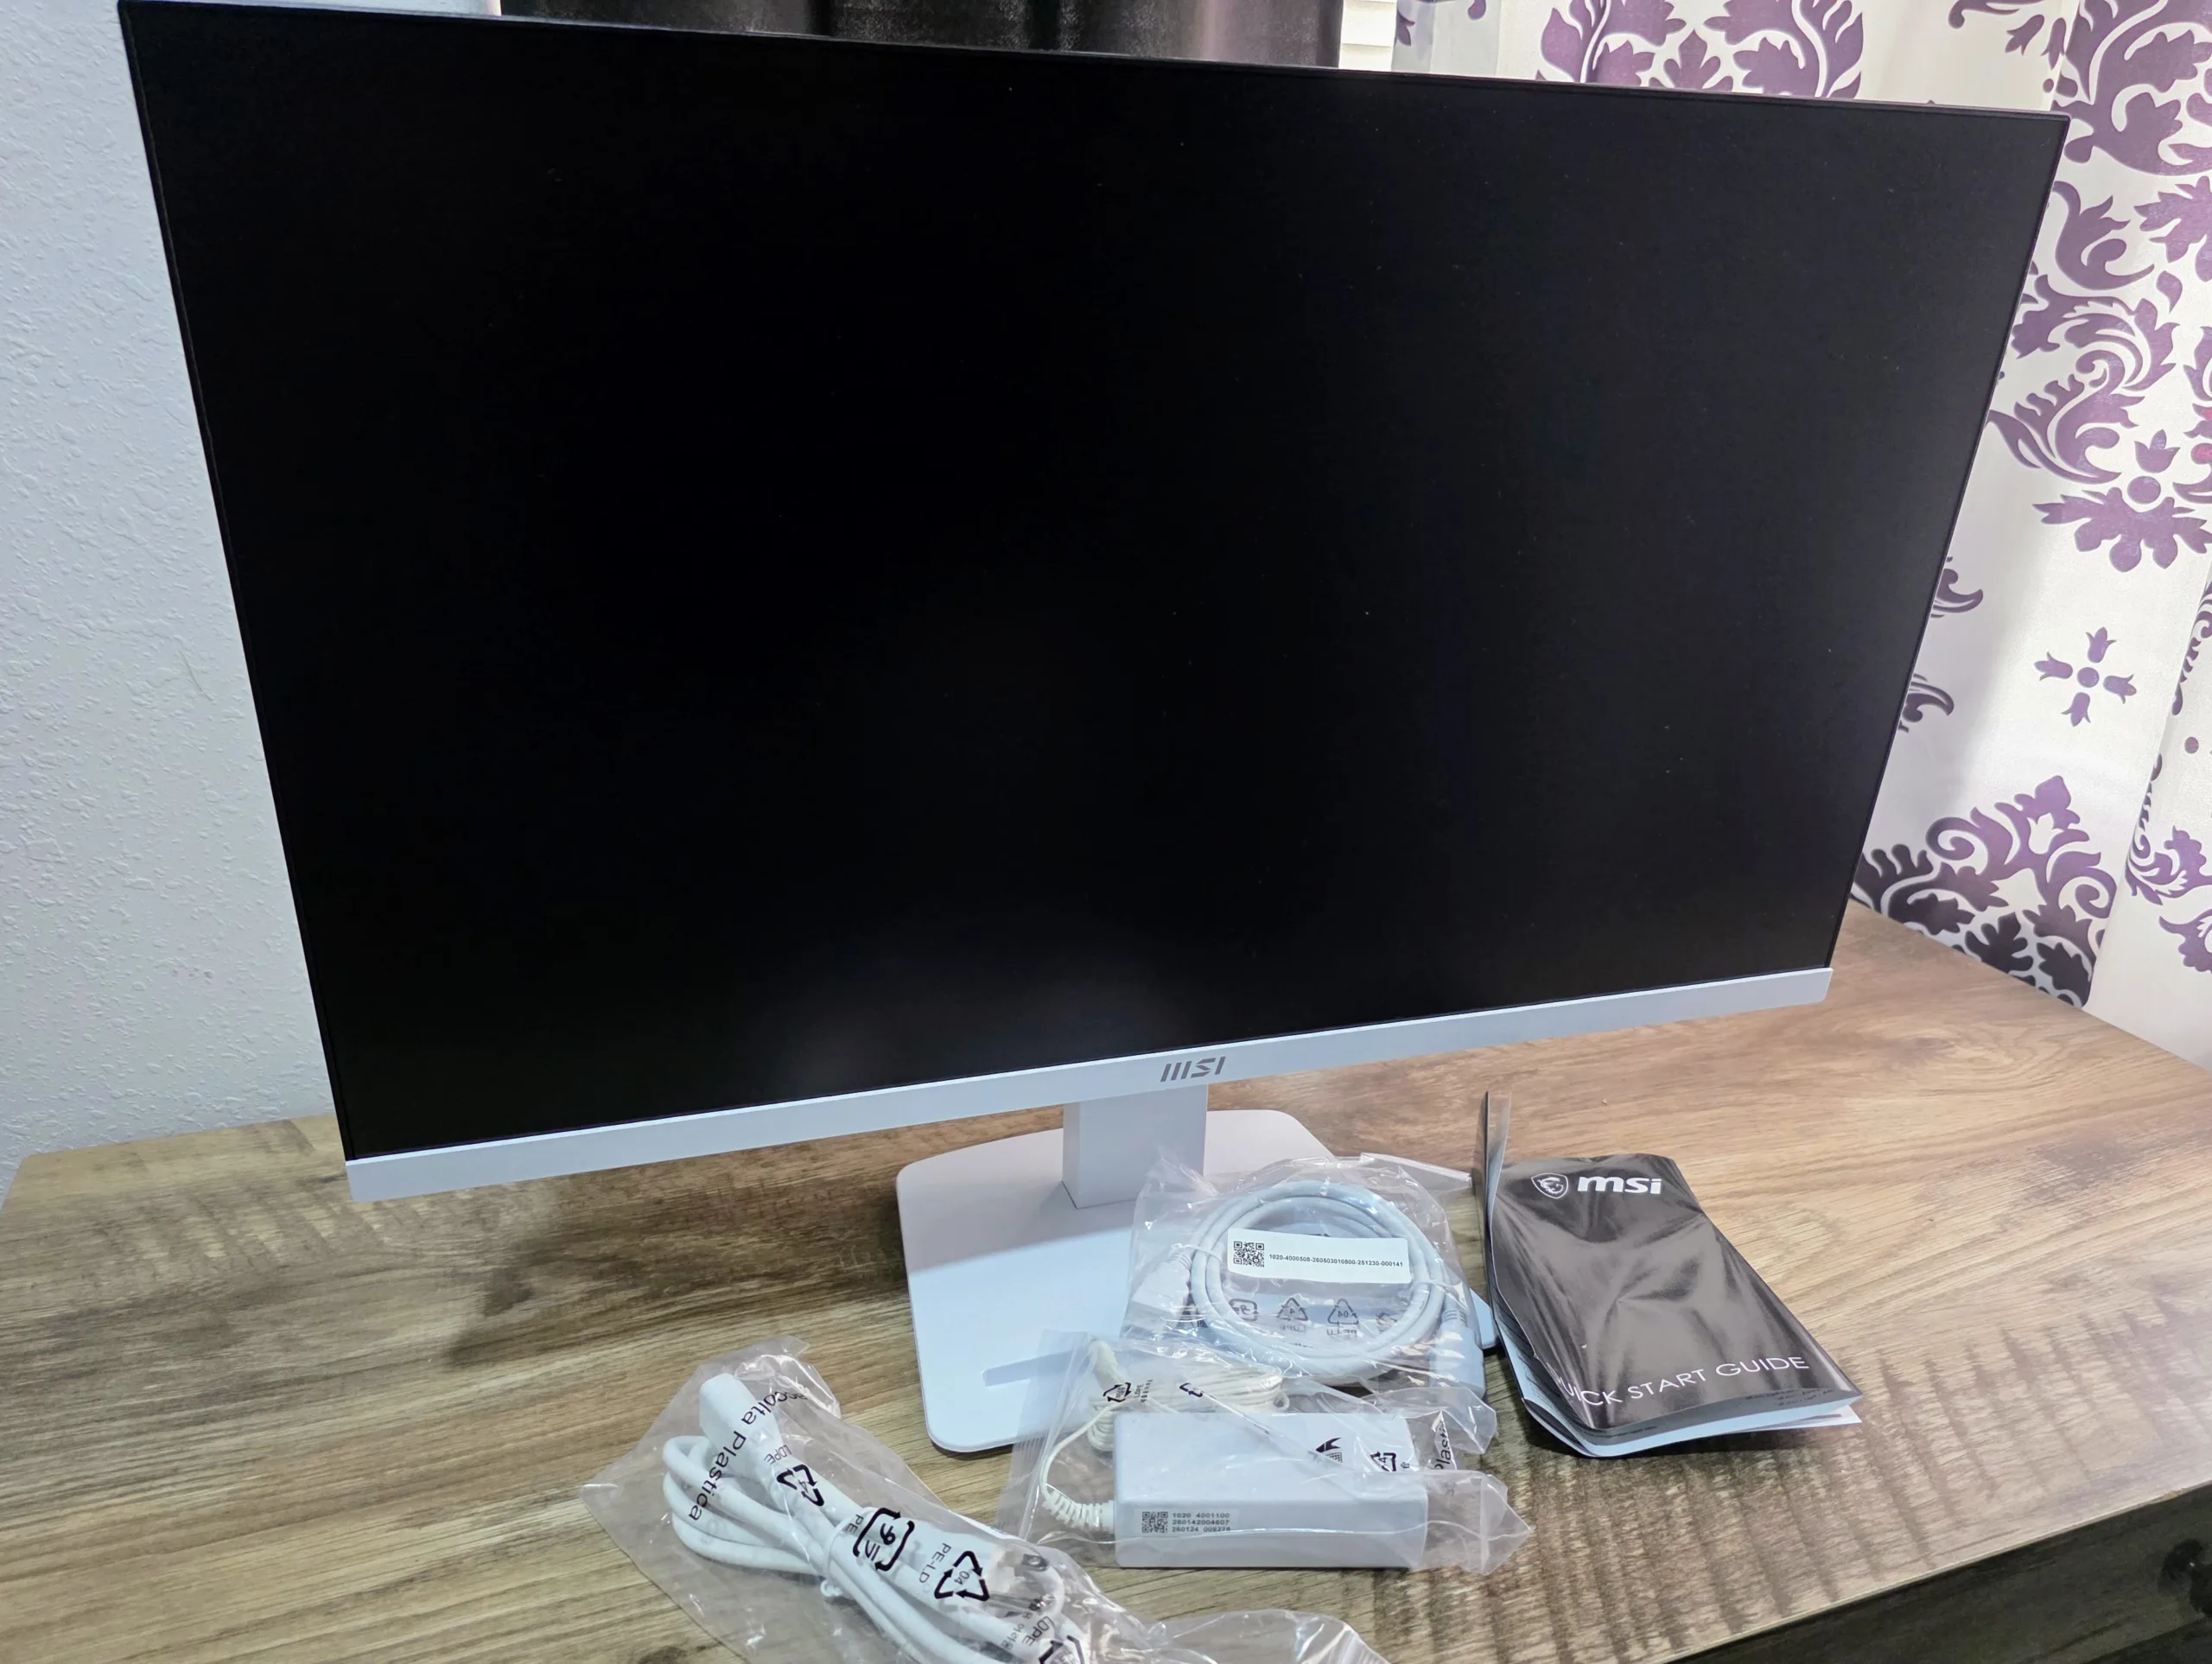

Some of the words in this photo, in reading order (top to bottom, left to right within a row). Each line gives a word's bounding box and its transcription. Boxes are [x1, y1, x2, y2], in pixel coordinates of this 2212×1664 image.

[1577, 1176, 1662, 1195] msi
[1552, 1369, 1624, 1406] UICK
[1628, 1369, 1707, 1399] START
[1715, 1356, 1809, 1377] GUIDE
[764, 1444, 792, 1465] LDPE
[689, 1431, 747, 1521] Plastica
[796, 1479, 809, 1493] 4
[845, 1514, 864, 1534] PE
[918, 1542, 951, 1584] PE-LD
[953, 1569, 970, 1585] 04
[1022, 1616, 1055, 1647] LDPE
